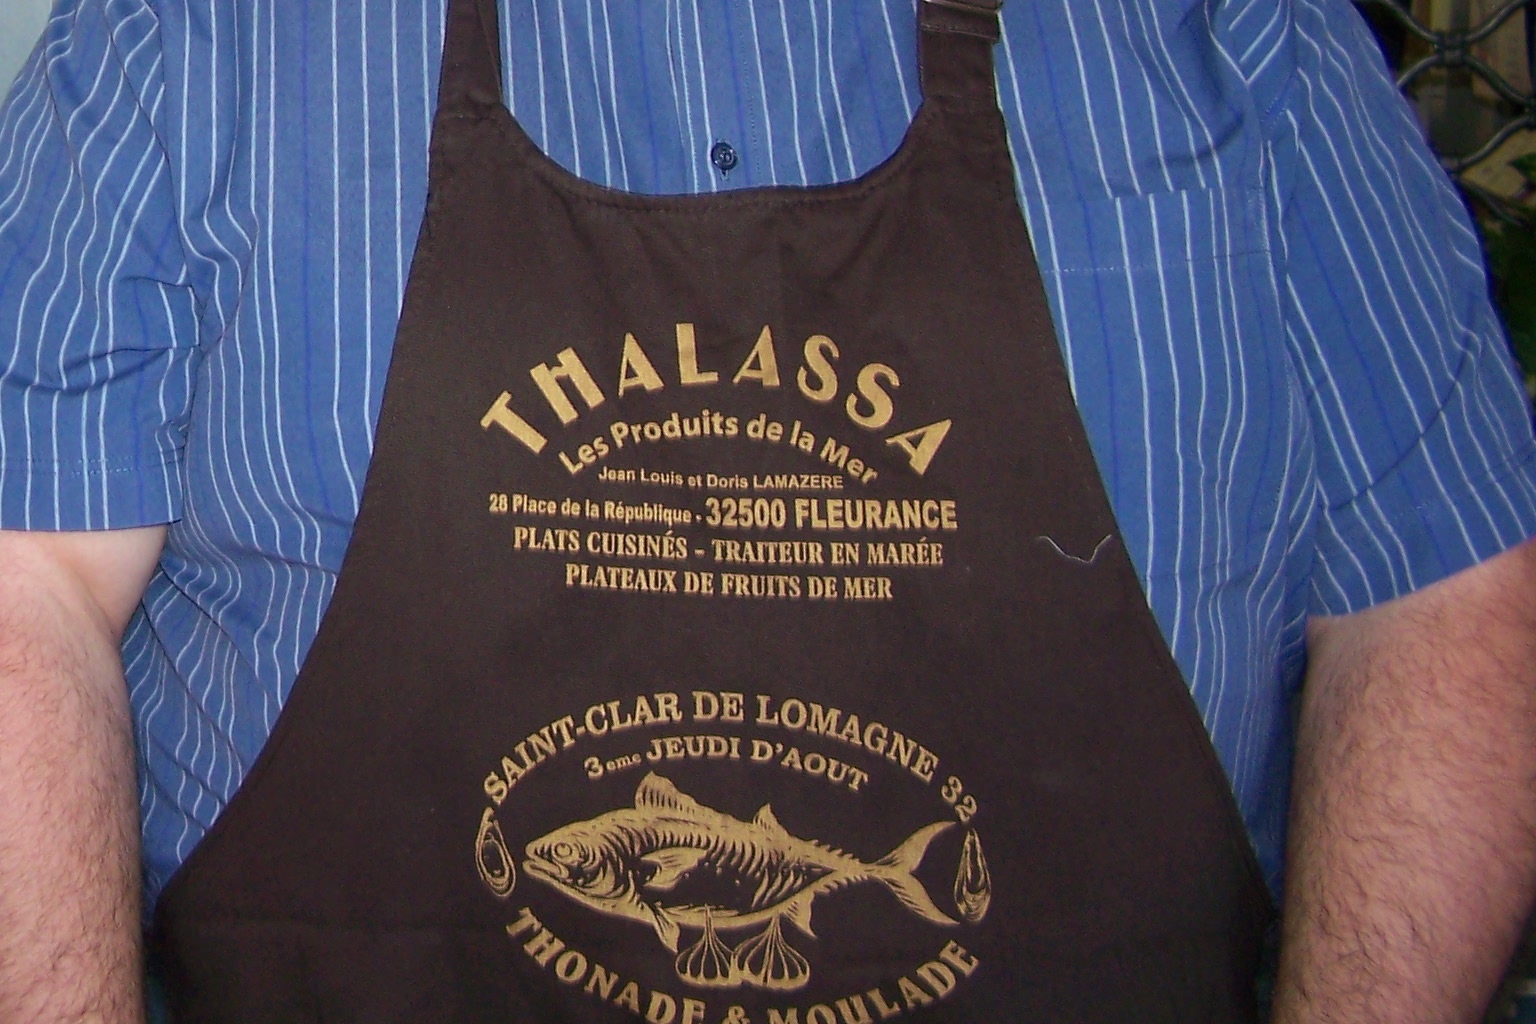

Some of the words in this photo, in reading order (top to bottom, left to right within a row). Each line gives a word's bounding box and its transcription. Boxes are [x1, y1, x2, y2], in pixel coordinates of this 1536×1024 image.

[479, 321, 953, 476] THALASSA
[557, 434, 610, 476] Les
[609, 407, 740, 450] Produits
[746, 412, 784, 442] de
[788, 419, 816, 454] la
[818, 436, 879, 485] Mer
[597, 465, 636, 483] Jean
[639, 467, 684, 487] Louis
[687, 475, 704, 489] et
[706, 473, 749, 490] Doris
[752, 473, 845, 490] LAMAZERE
[489, 493, 508, 514] 28
[512, 493, 557, 516] Place
[561, 497, 582, 518] de
[585, 498, 600, 519] la
[603, 499, 693, 526] République
[704, 496, 788, 529] 32500
[794, 498, 959, 531] FLEURANCE
[513, 526, 581, 554] PLATS
[586, 530, 689, 561] CUISINÉS
[711, 537, 825, 566] TRAITEUR
[830, 541, 861, 567] EN
[866, 536, 945, 567] MARÉE
[565, 562, 678, 595] PLATEAUX
[683, 570, 715, 596] DE
[720, 573, 802, 599] FRUITS
[806, 575, 839, 600] DE
[843, 576, 894, 601] MER
[483, 691, 684, 806] SAINT-CLAR
[691, 690, 745, 722] DE
[755, 693, 941, 784] LOMAGNE
[939, 775, 979, 824] 32
[645, 735, 743, 762] JEUDI
[749, 737, 870, 792] D'AOUT
[504, 906, 707, 1024] THONADE
[766, 937, 981, 1024] MOULADE
